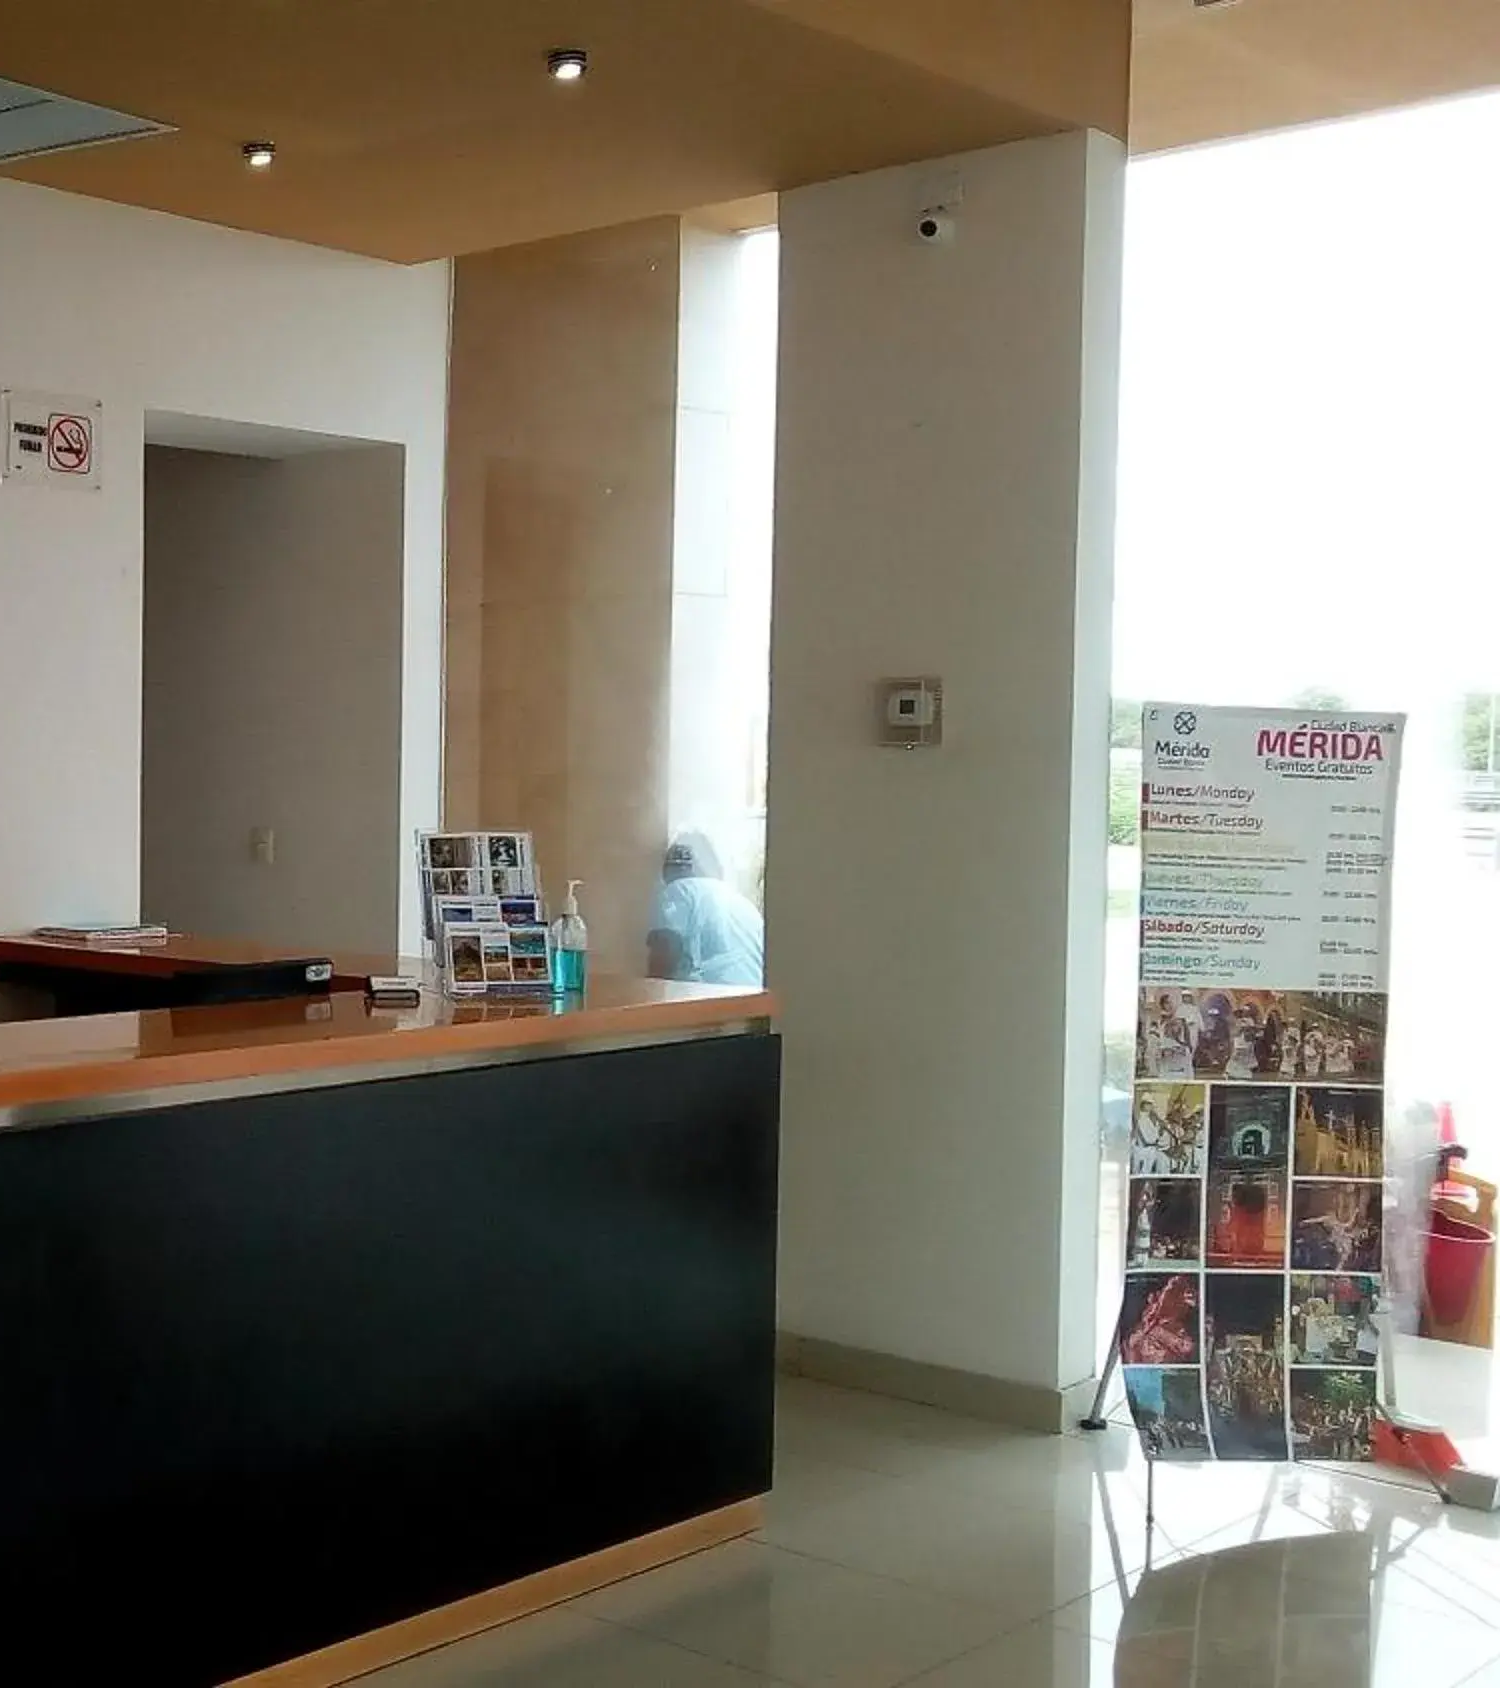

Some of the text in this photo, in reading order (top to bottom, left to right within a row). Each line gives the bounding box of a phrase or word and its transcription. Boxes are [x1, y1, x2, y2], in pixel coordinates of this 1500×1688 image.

[1154, 739, 1210, 759] Mérida
[1257, 722, 1384, 761] MÉRIDA
[1265, 759, 1315, 773] Eventos
